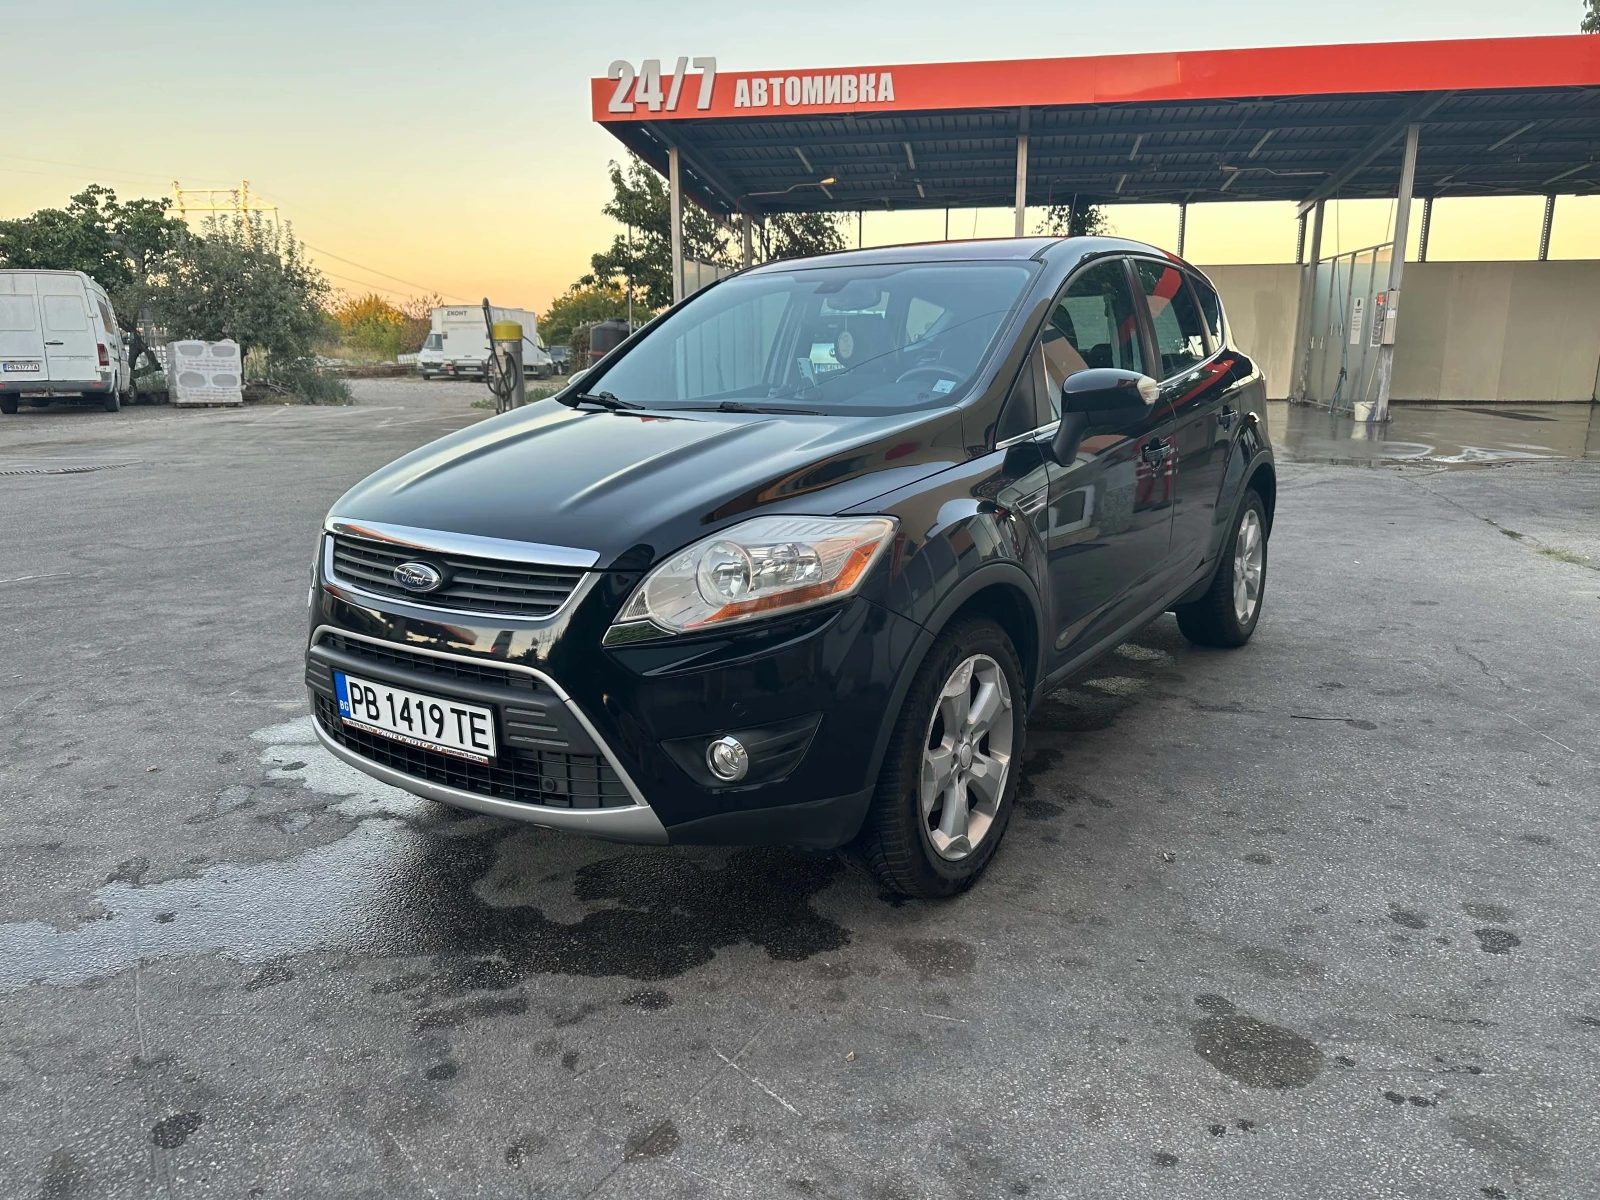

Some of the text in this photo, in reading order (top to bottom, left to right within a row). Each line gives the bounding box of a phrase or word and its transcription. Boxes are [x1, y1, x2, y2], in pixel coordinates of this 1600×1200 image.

[608, 57, 895, 112] 24/7 АВТОМИВКА
[401, 568, 426, 586] Ford
[339, 699, 350, 712] BG
[349, 681, 490, 751] PB 1419 TE
